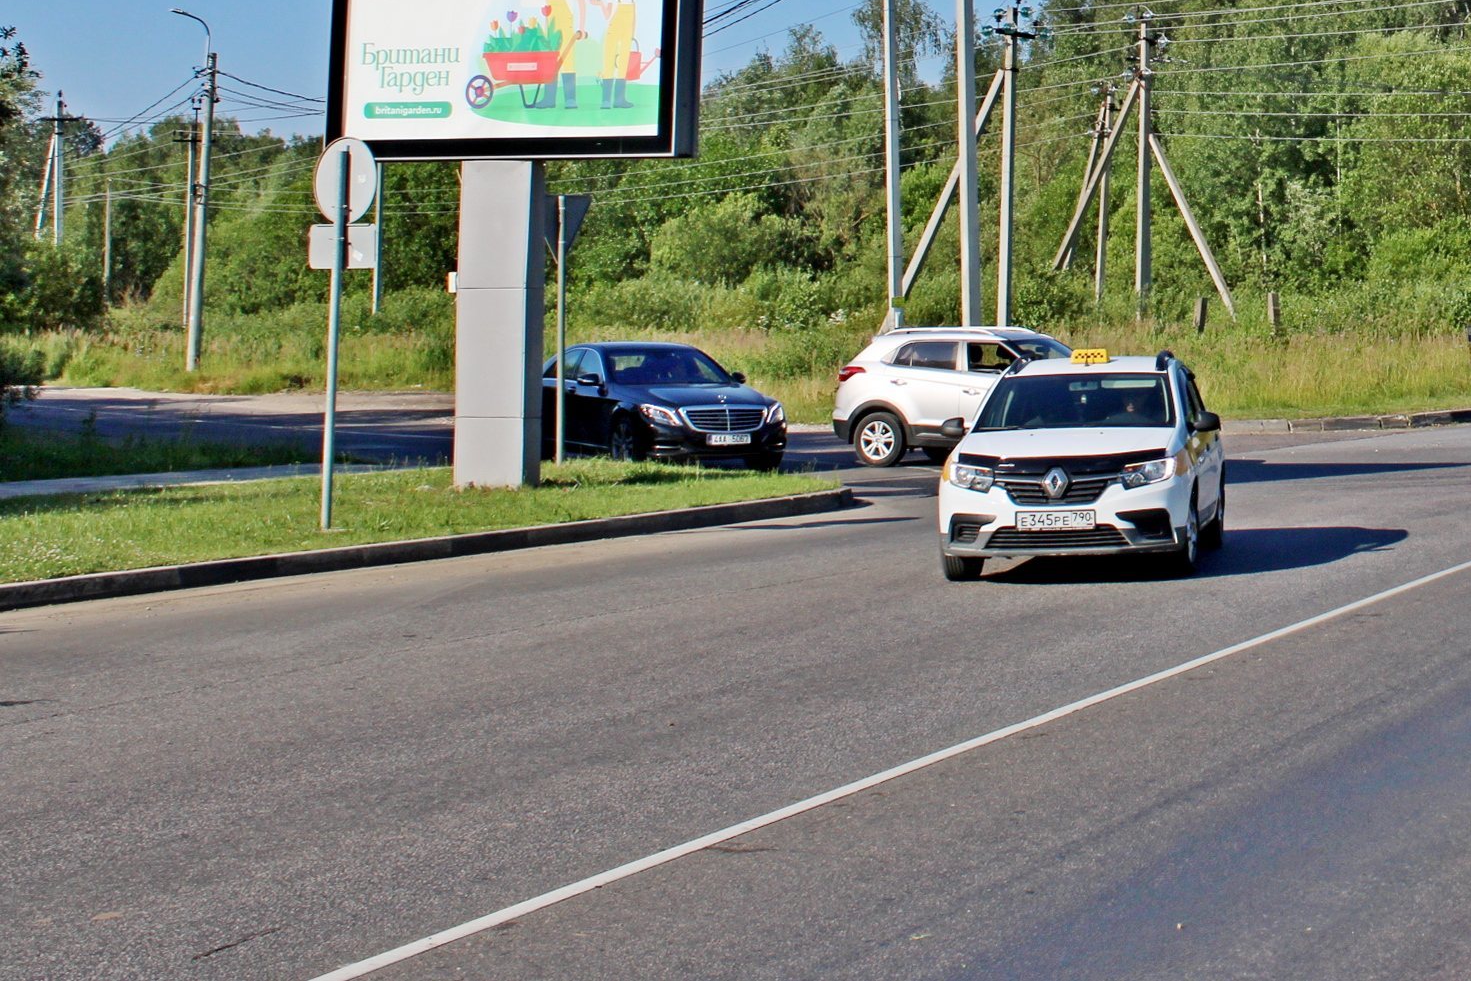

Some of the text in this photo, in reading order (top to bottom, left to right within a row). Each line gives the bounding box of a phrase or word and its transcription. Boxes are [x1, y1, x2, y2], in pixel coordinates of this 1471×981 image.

[361, 42, 460, 71] Британи
[380, 66, 450, 96] Гарден
[375, 105, 443, 117] britanigarden.ru
[1072, 512, 1091, 522] 790
